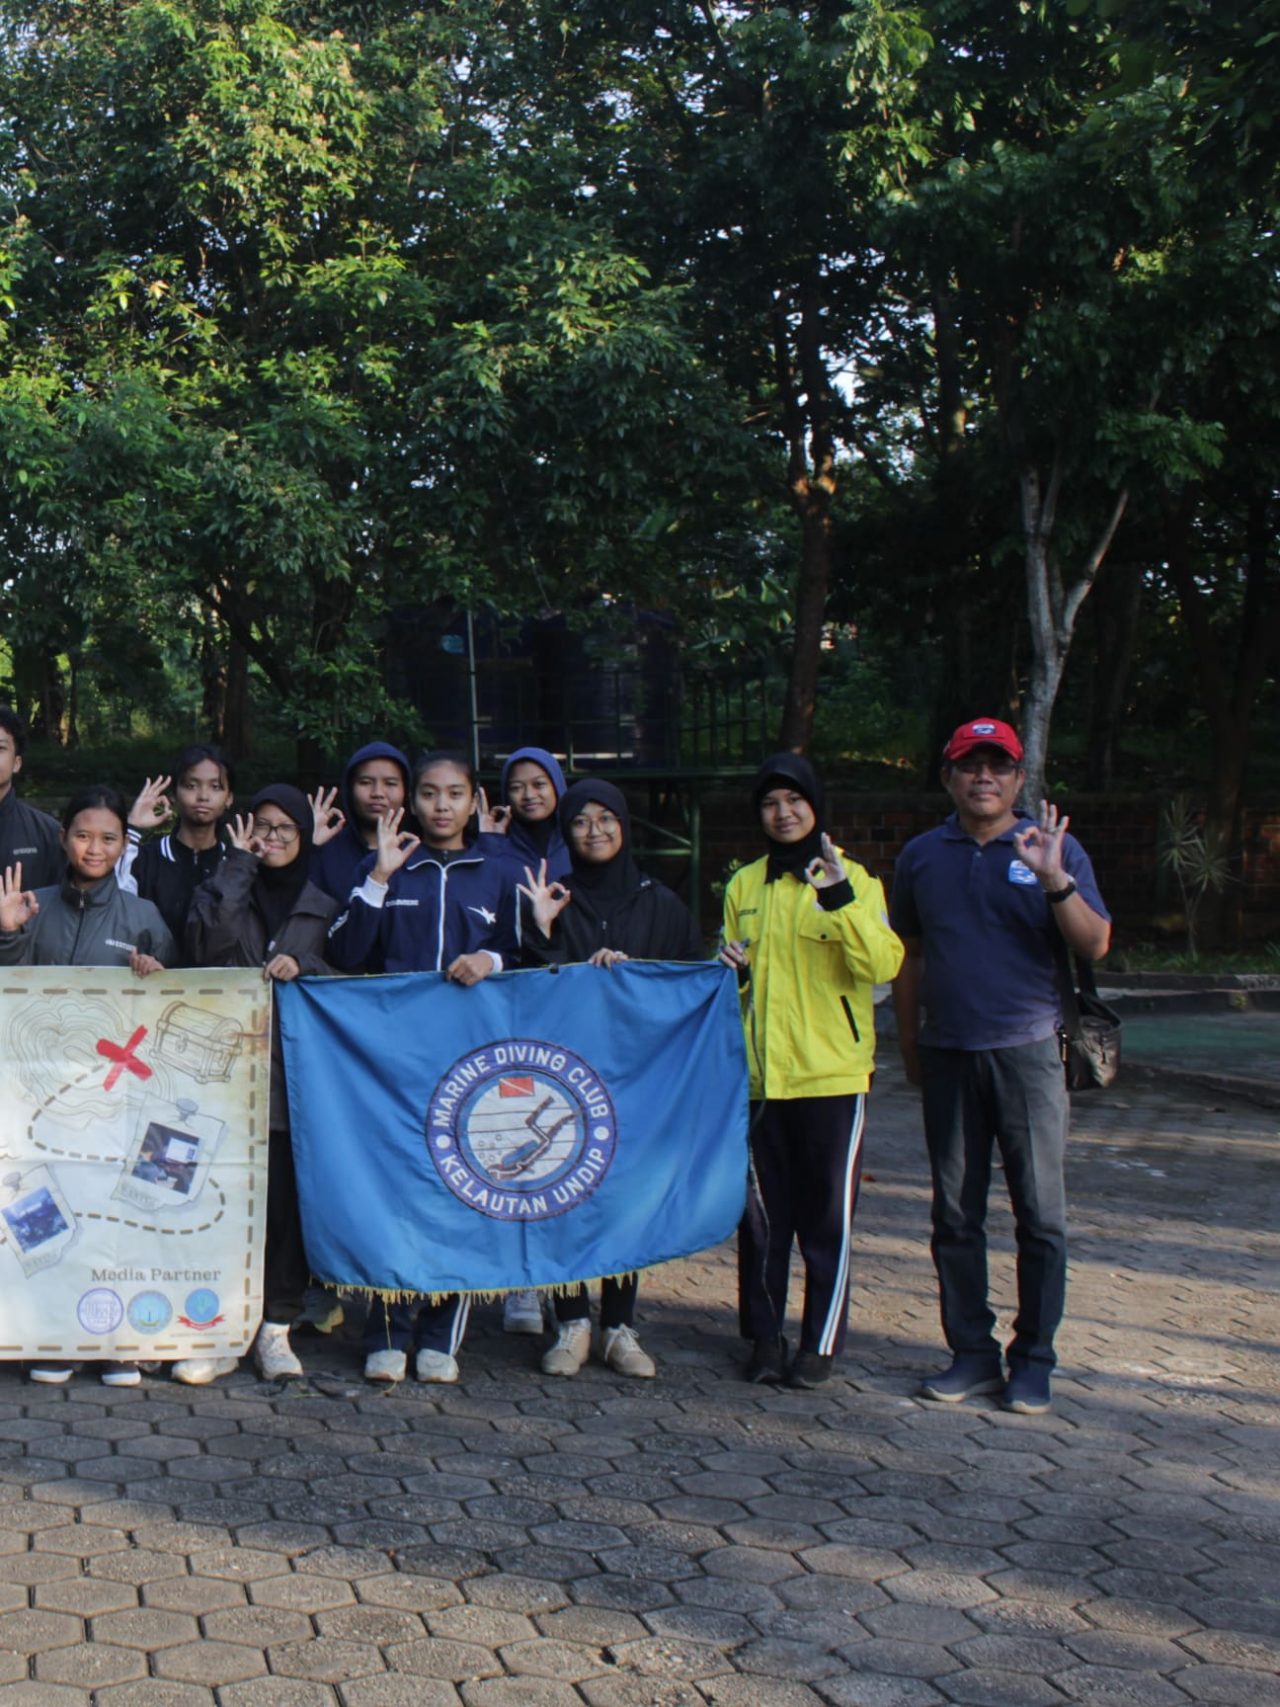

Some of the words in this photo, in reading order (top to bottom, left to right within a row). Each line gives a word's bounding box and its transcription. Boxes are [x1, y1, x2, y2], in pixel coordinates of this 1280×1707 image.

[433, 1056, 490, 1128] MARINE
[495, 1046, 566, 1071] DIVING
[568, 1067, 609, 1118] CLUB
[440, 1154, 548, 1214] KELAUTAN
[553, 1147, 606, 1204] UNDIP
[91, 1268, 145, 1282] Media
[151, 1268, 222, 1282] Partner
